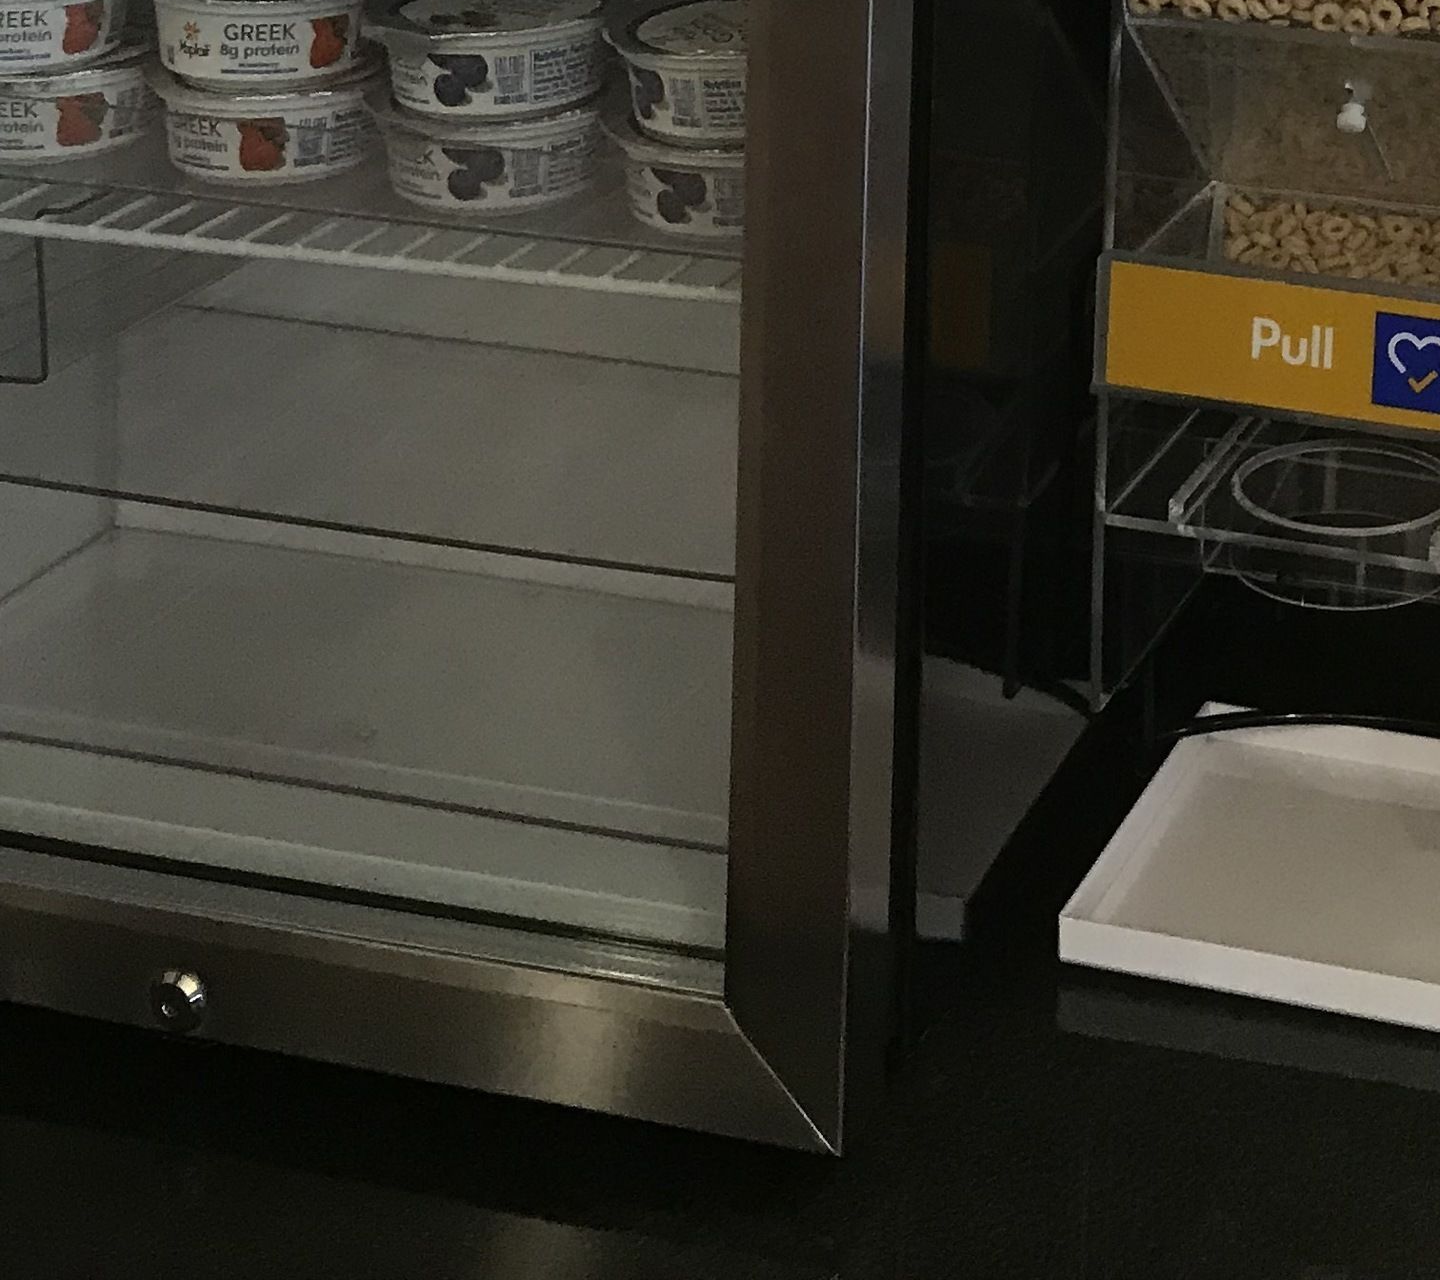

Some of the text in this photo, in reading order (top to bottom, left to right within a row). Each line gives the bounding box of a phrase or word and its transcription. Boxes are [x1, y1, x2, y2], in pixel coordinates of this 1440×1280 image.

[224, 22, 297, 42] GREEK
[243, 43, 300, 60] protein
[1251, 316, 1334, 370] Pull
